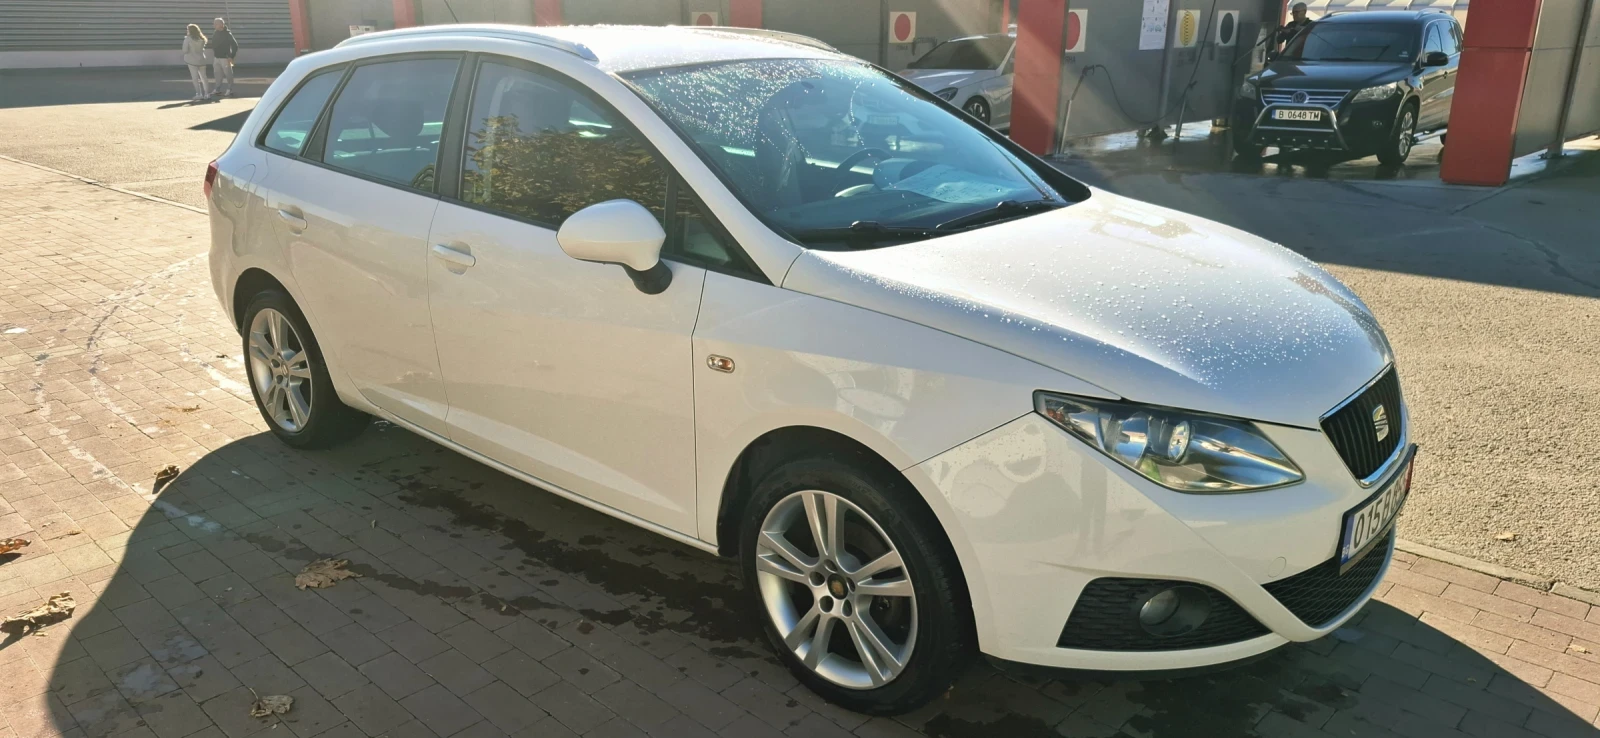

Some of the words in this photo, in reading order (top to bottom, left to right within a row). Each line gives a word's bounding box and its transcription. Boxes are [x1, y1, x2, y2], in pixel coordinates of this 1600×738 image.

[1279, 110, 1284, 119] B
[1288, 111, 1307, 119] 0648
[1309, 111, 1320, 120] TM
